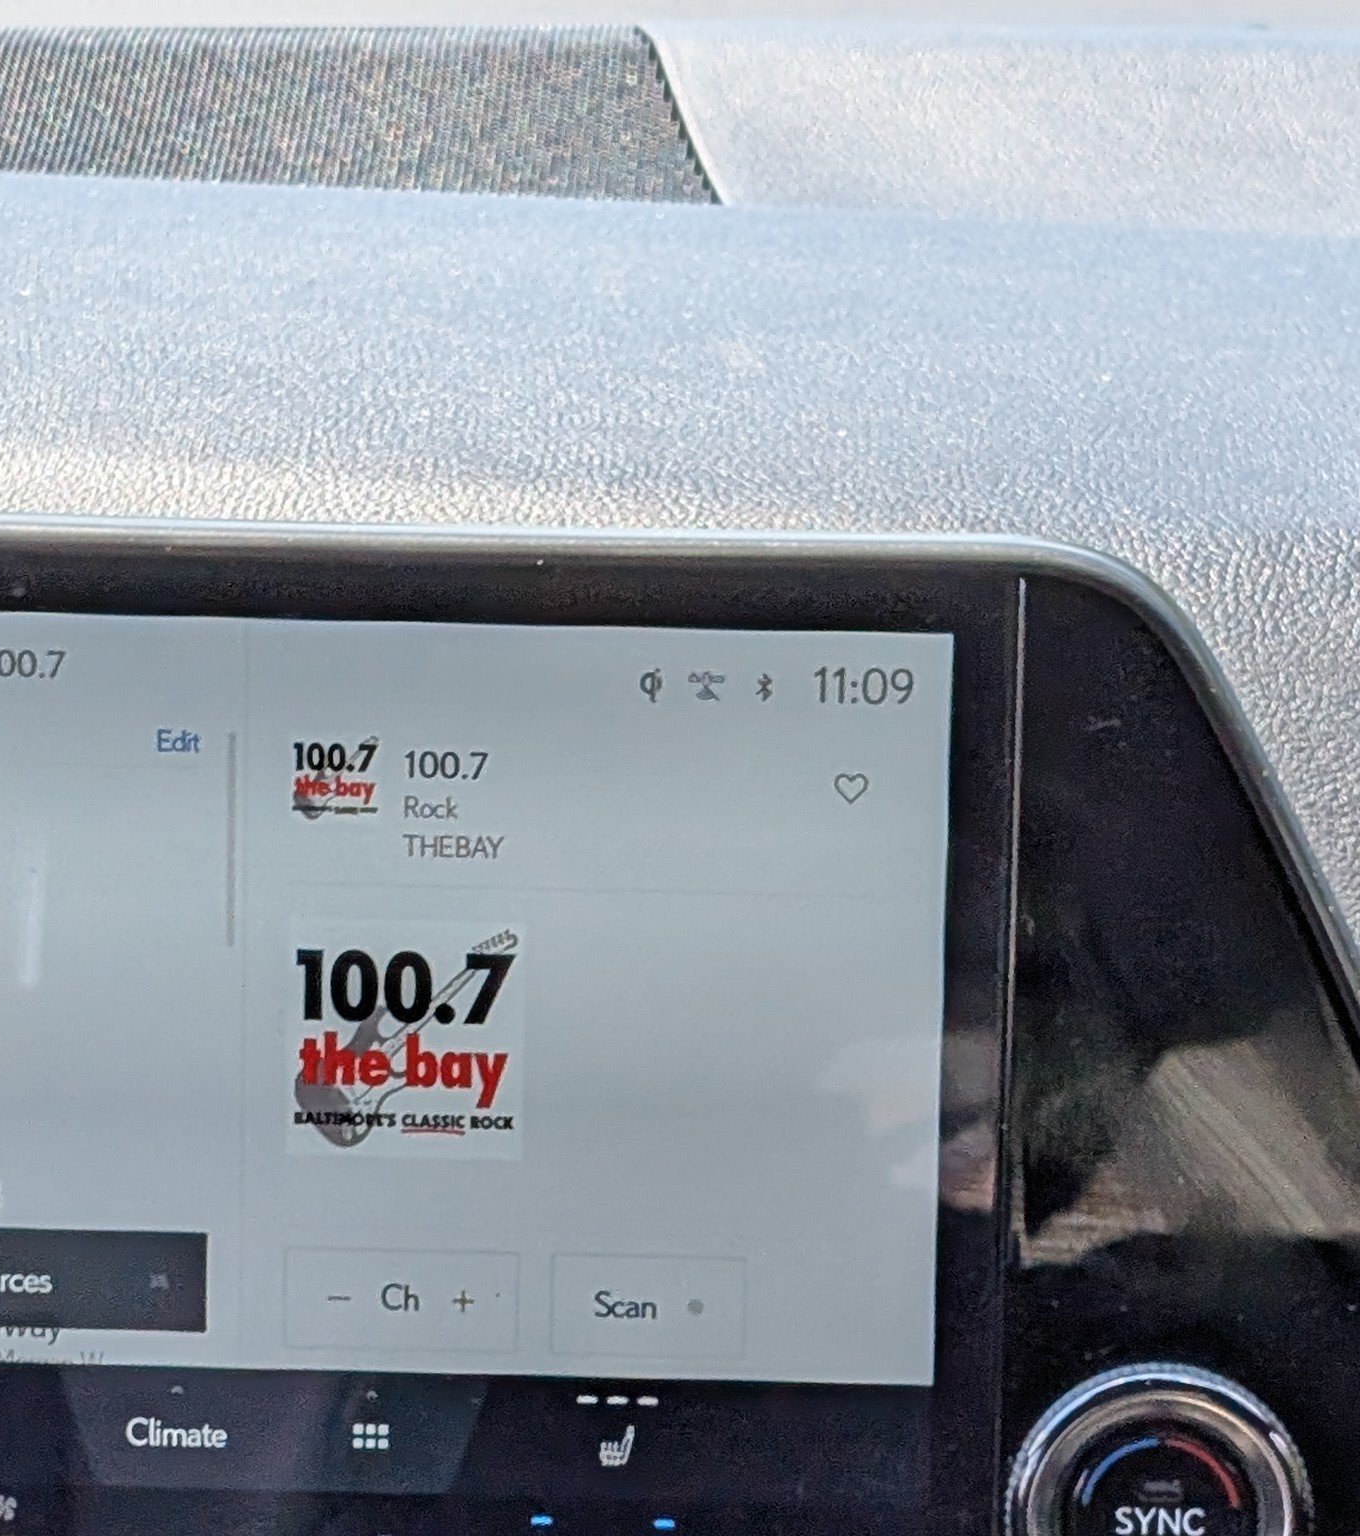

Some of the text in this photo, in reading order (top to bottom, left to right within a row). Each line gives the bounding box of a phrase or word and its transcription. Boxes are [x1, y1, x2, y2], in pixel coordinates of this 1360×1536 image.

[813, 666, 914, 705] 11:09
[156, 729, 201, 754] Edit
[292, 742, 379, 773] 100.7
[403, 749, 489, 781] 100.7
[294, 773, 377, 806] the bay
[403, 795, 459, 821] Rock
[402, 833, 506, 860] THEBAY
[295, 948, 517, 1025] 100.7
[299, 1031, 509, 1109] the bay
[401, 1114, 465, 1130] CLASSIC
[469, 1115, 515, 1130] ROCK
[381, 1283, 420, 1313] Ch
[594, 1291, 658, 1319] Scan
[126, 1418, 229, 1449] Climate
[1114, 1506, 1207, 1536] SYNC
